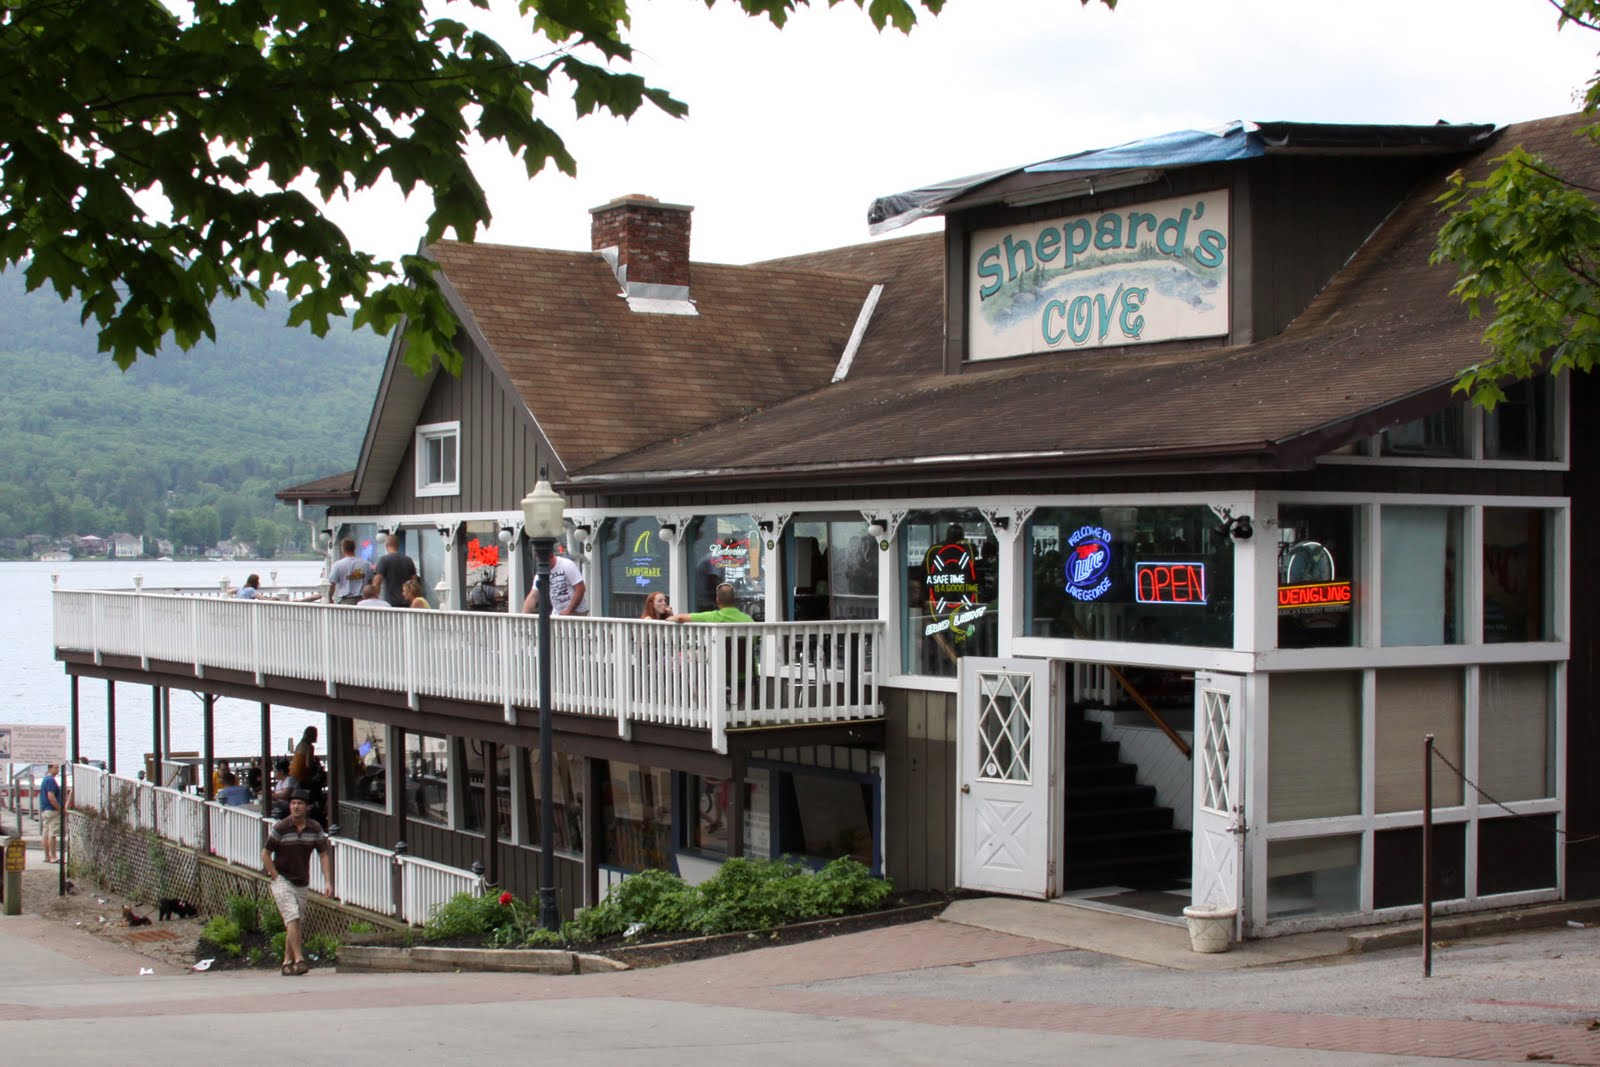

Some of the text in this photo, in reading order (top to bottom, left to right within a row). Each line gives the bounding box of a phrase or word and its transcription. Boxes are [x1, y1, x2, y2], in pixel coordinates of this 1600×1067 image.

[977, 201, 1227, 301] Shepard's
[1041, 282, 1149, 346] COVE
[1067, 525, 1112, 547] WELCOME TO
[625, 566, 661, 577] LANDSHARK
[926, 574, 965, 584] A SAFE TIME
[946, 583, 965, 593] GOOD
[965, 583, 979, 593] TIME
[1064, 576, 1112, 601] LAKE GEORGE
[1138, 565, 1204, 603] OPEN
[1279, 586, 1351, 604] UENGLING
[925, 619, 950, 636] BUD
